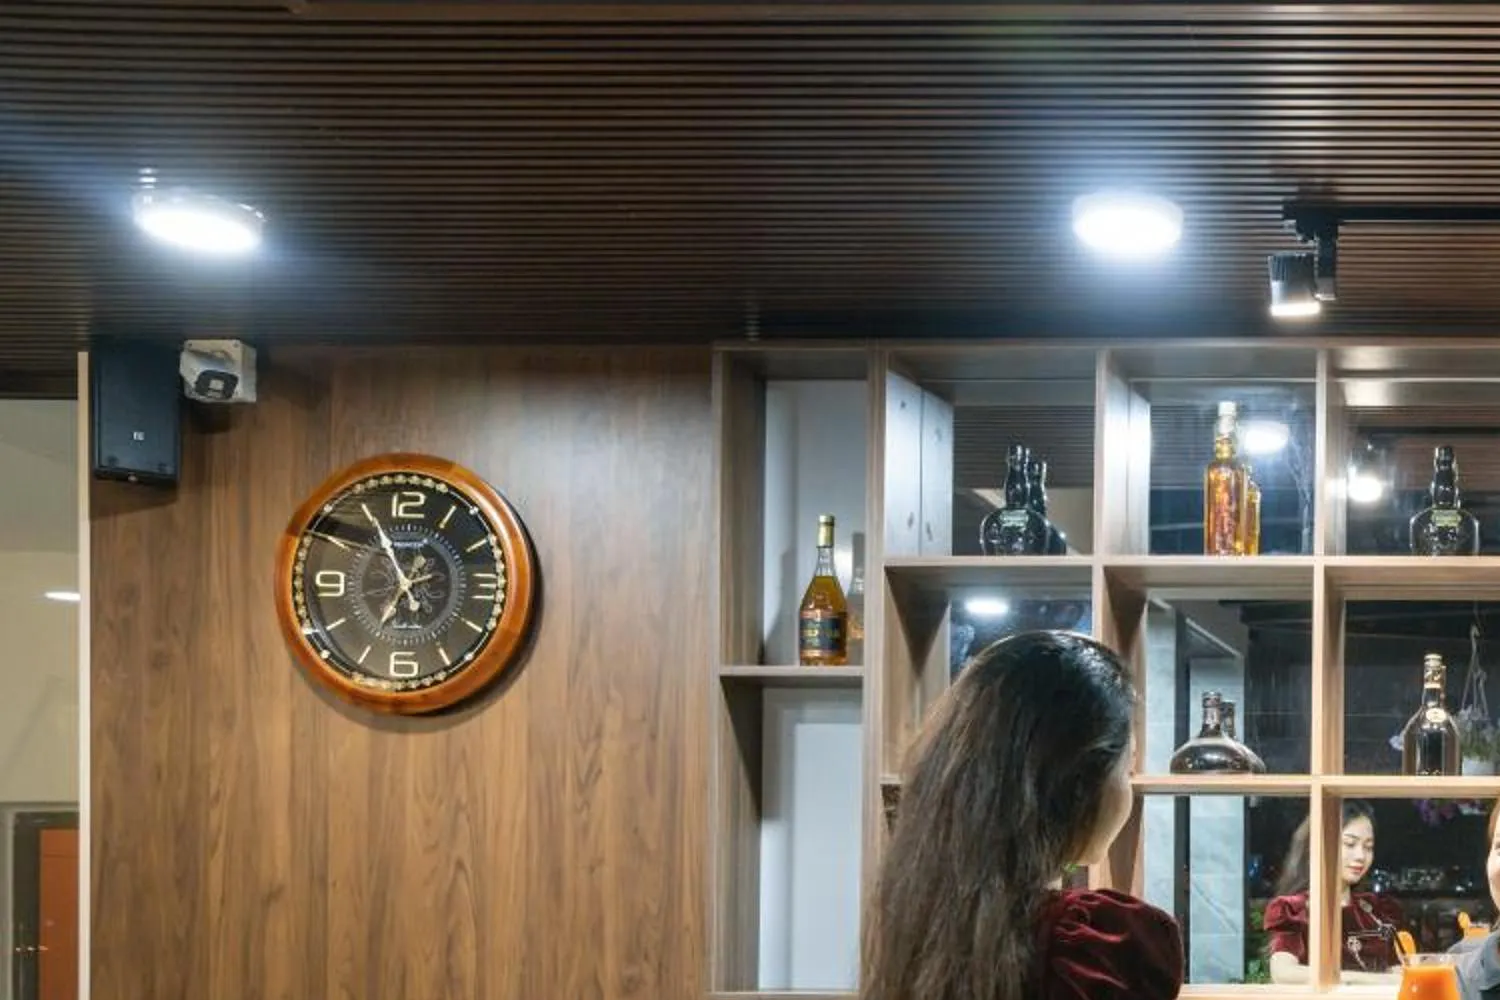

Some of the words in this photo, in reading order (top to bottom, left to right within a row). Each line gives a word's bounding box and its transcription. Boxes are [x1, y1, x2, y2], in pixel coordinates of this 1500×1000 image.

[391, 491, 426, 519] 12
[315, 570, 346, 598] 9
[389, 651, 419, 678] 6
